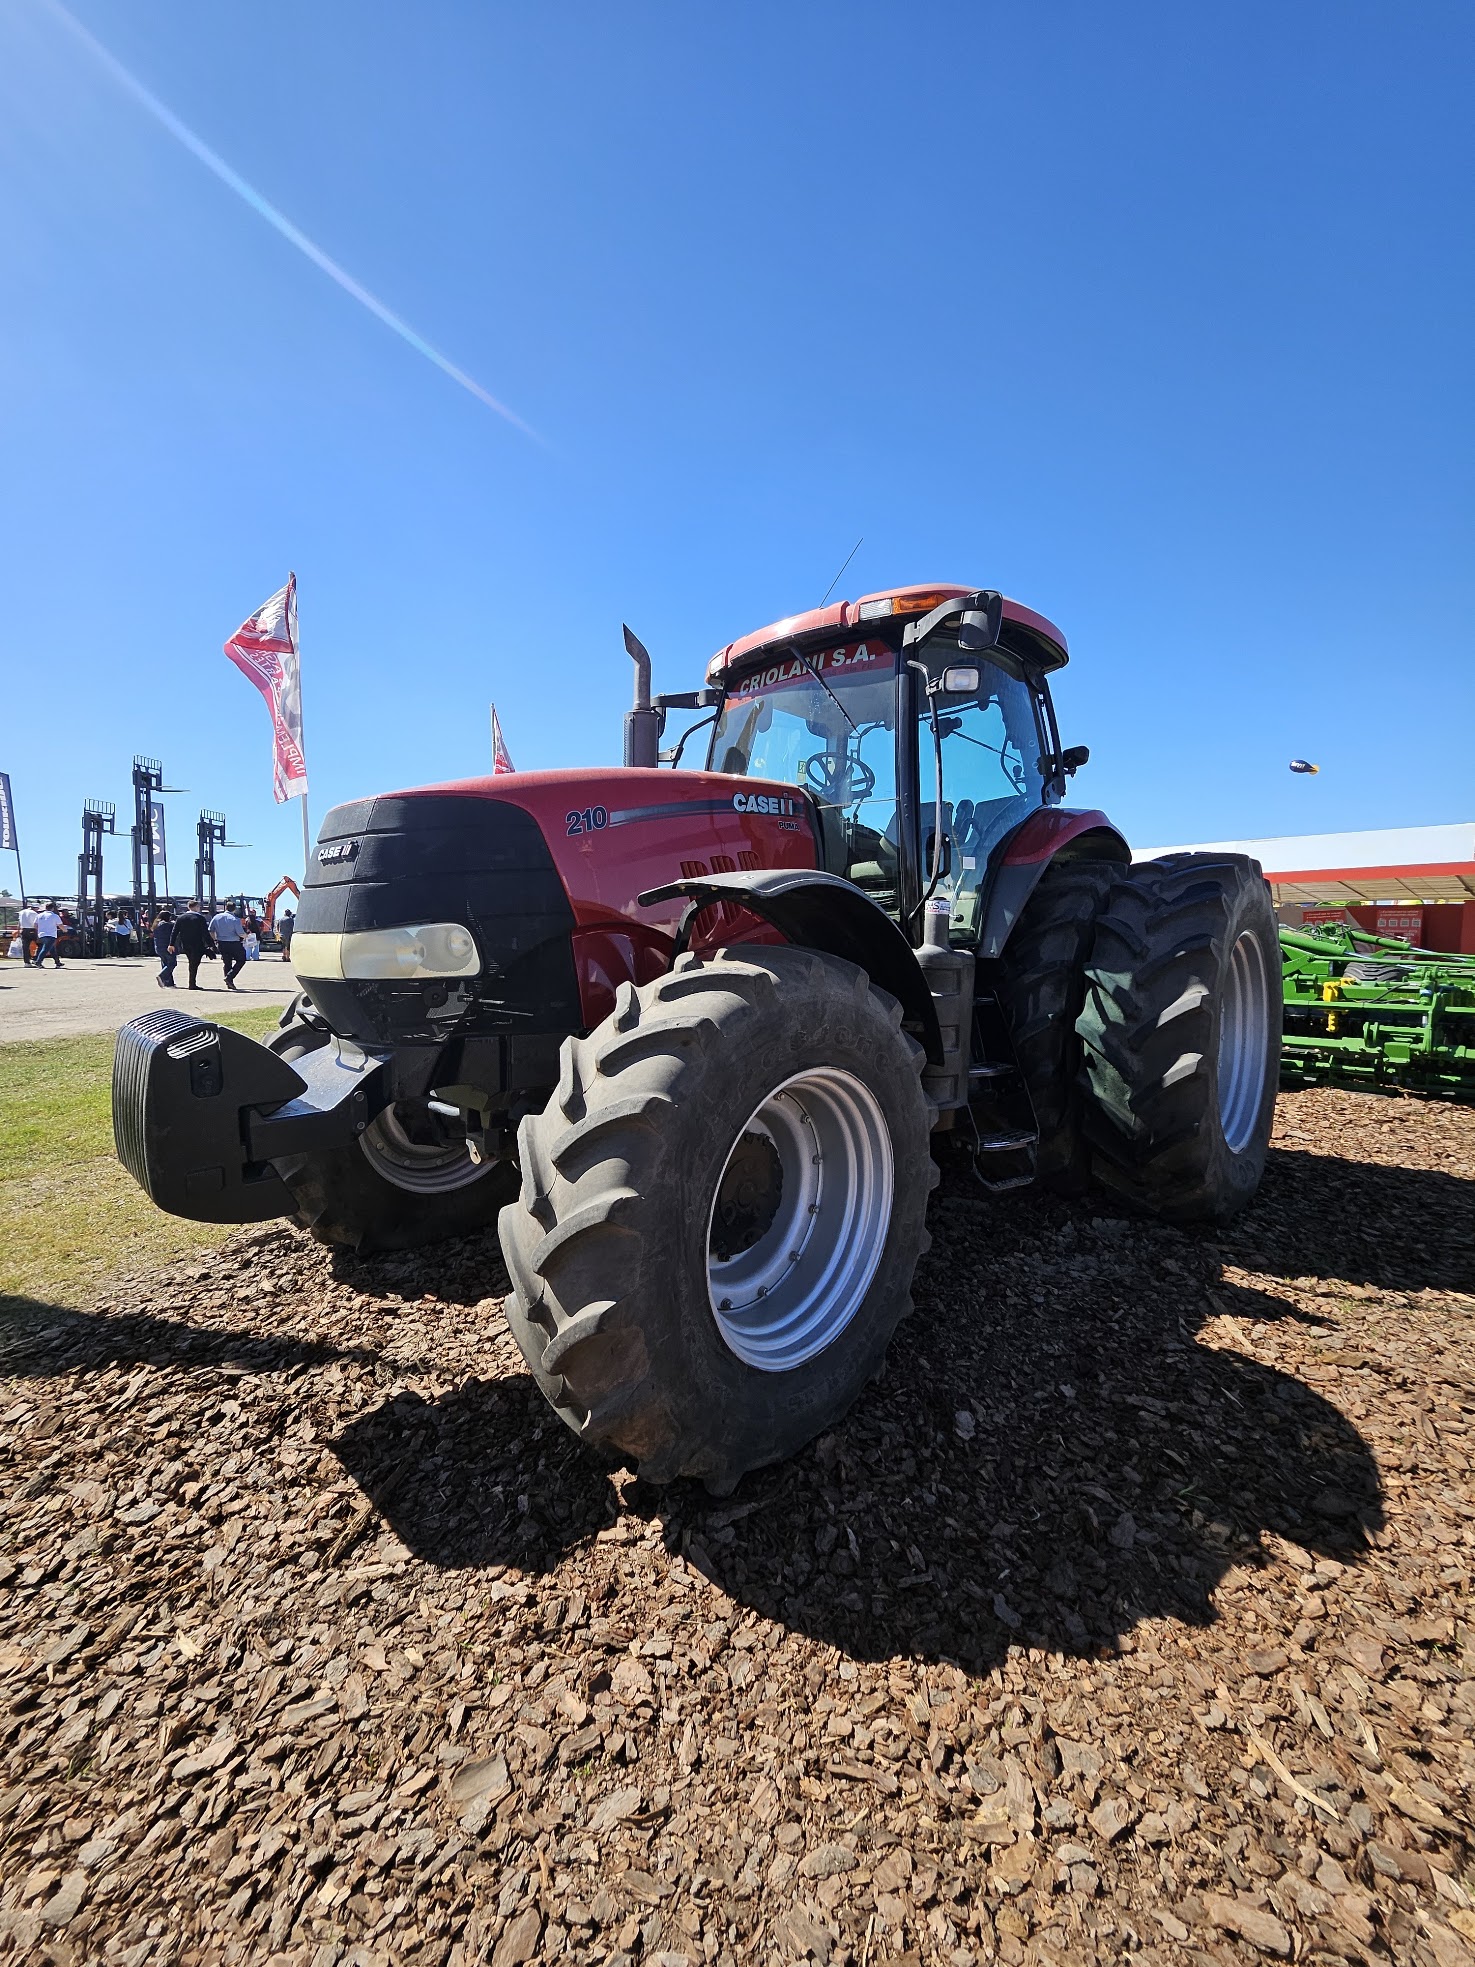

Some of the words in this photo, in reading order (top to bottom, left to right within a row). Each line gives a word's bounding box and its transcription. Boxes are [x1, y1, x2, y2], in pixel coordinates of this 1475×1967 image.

[739, 652, 825, 696] CRIOLANI
[831, 643, 876, 667] S.A.
[566, 805, 608, 837] 210
[778, 820, 800, 832] PUMA
[318, 846, 341, 861] CASE
